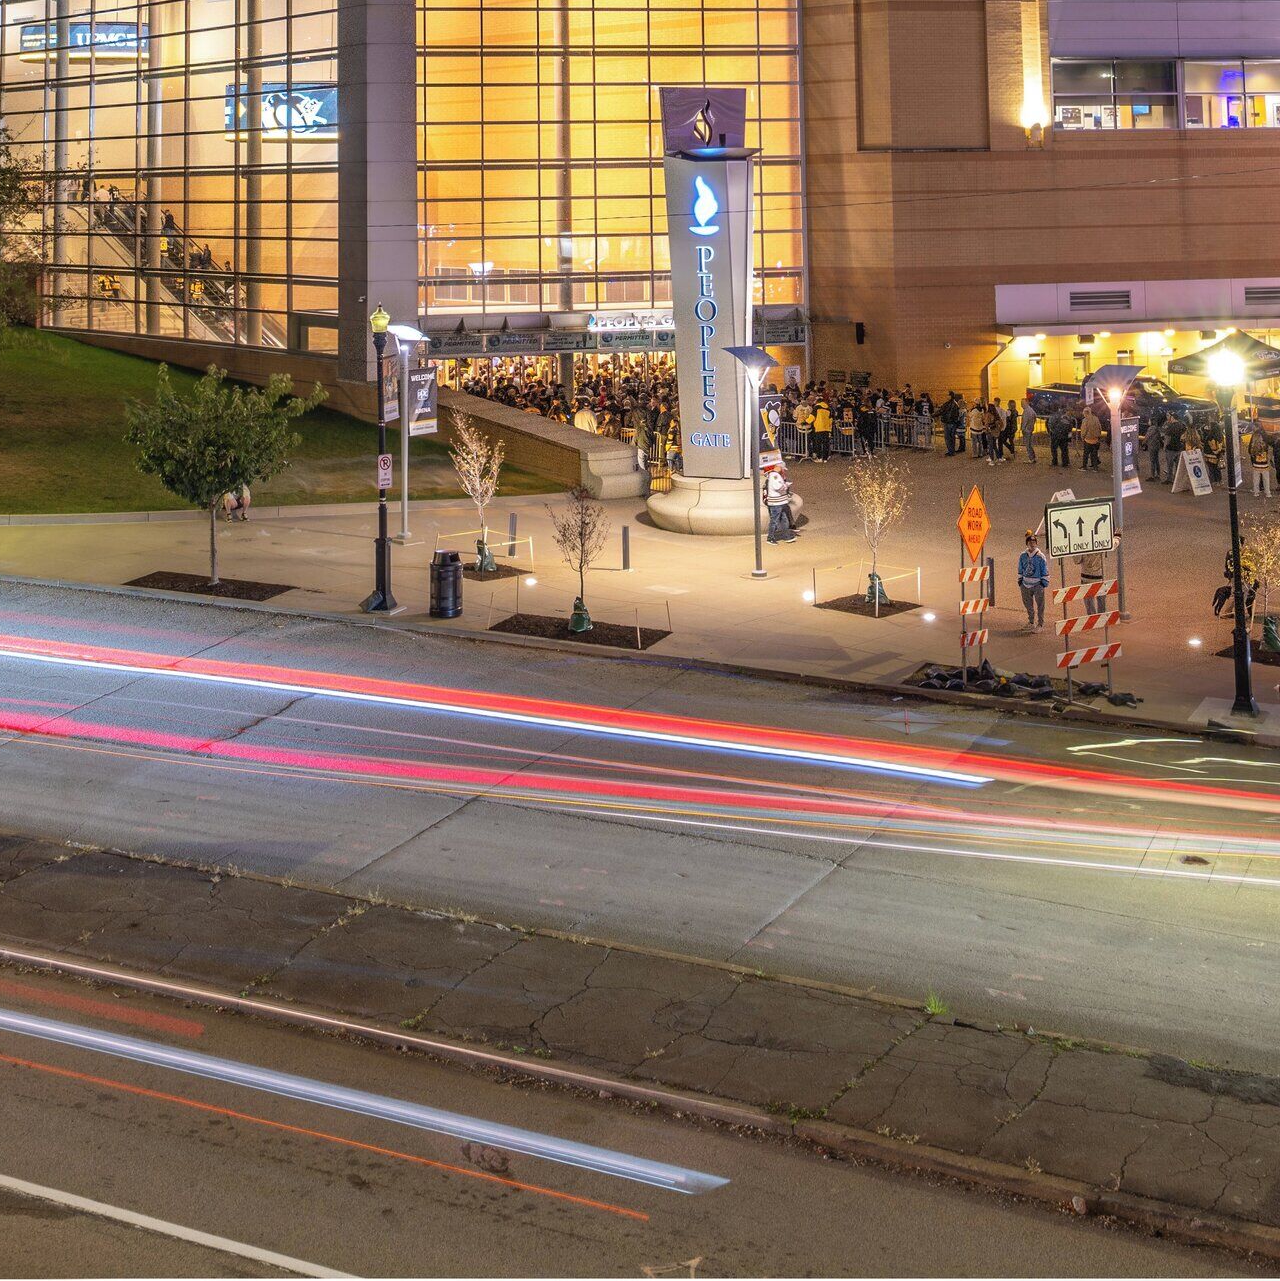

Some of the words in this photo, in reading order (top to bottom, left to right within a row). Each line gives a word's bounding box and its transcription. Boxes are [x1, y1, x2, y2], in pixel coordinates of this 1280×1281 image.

[694, 245, 719, 423] PEOPLES
[410, 372, 436, 382] WELCOME
[690, 432, 731, 448] GATE
[967, 507, 983, 518] ROAD
[967, 520, 983, 531] WORK
[1052, 544, 1069, 554] ONLY
[1073, 542, 1090, 551] ONLY
[1094, 539, 1111, 548] ONLY
